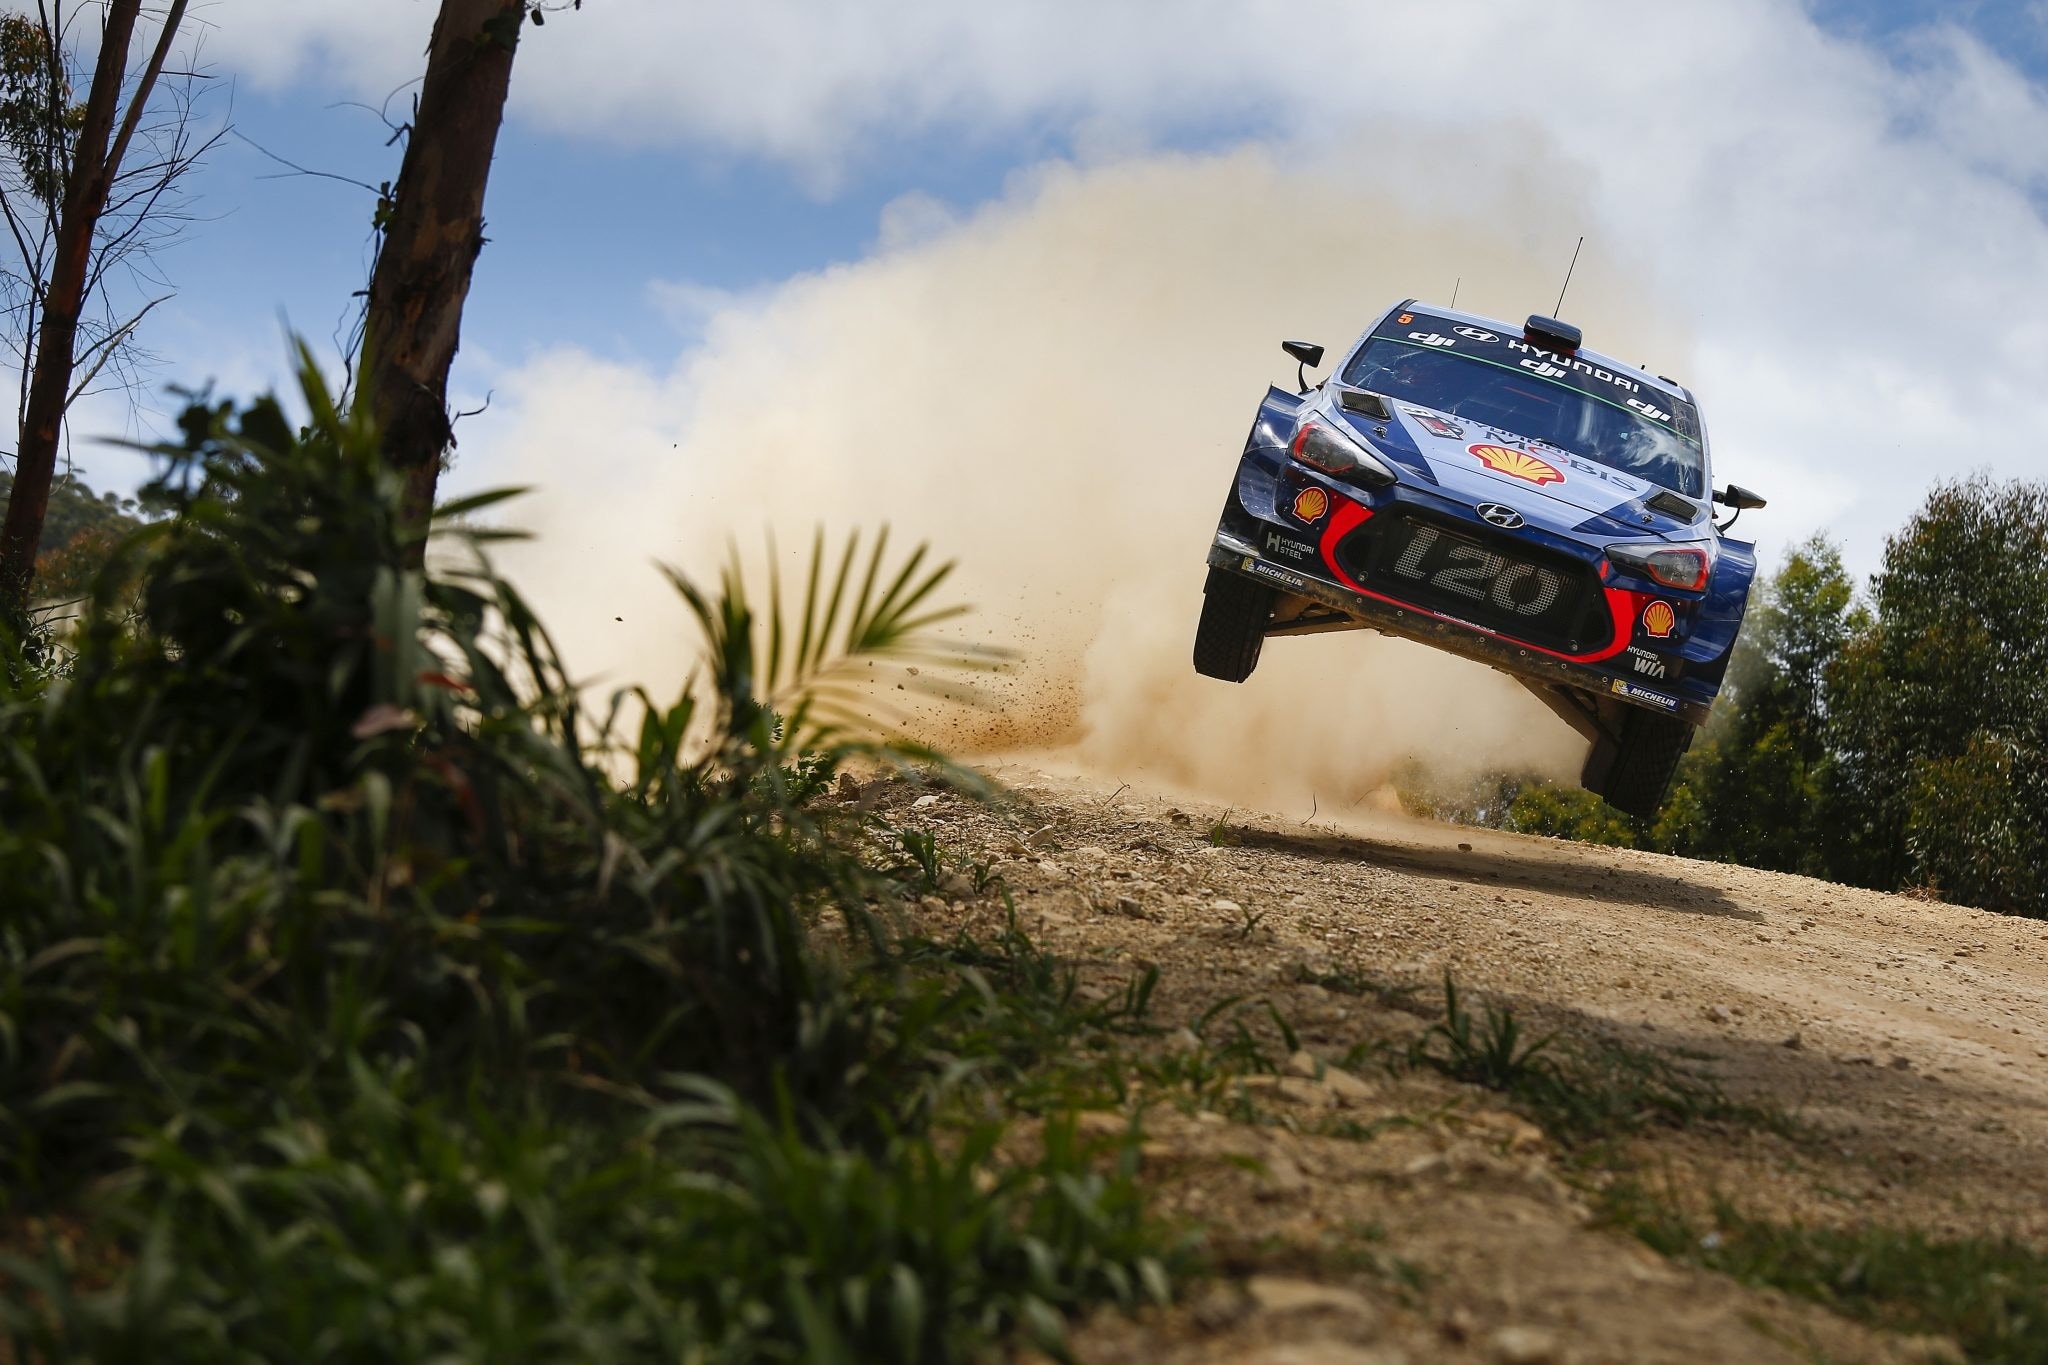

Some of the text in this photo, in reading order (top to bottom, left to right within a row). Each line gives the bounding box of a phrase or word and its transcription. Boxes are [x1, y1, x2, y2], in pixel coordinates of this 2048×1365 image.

[1397, 313, 1414, 325] 5
[1507, 339, 1640, 394] HYUNDAI
[1484, 431, 1638, 492] MOBIS
[1280, 546, 1303, 560] STEEL
[1281, 537, 1315, 555] HYUNDAI
[1256, 564, 1305, 587] MICHELIN
[1626, 645, 1659, 661] HYUNDAI
[1630, 687, 1677, 707] MICHELIN
